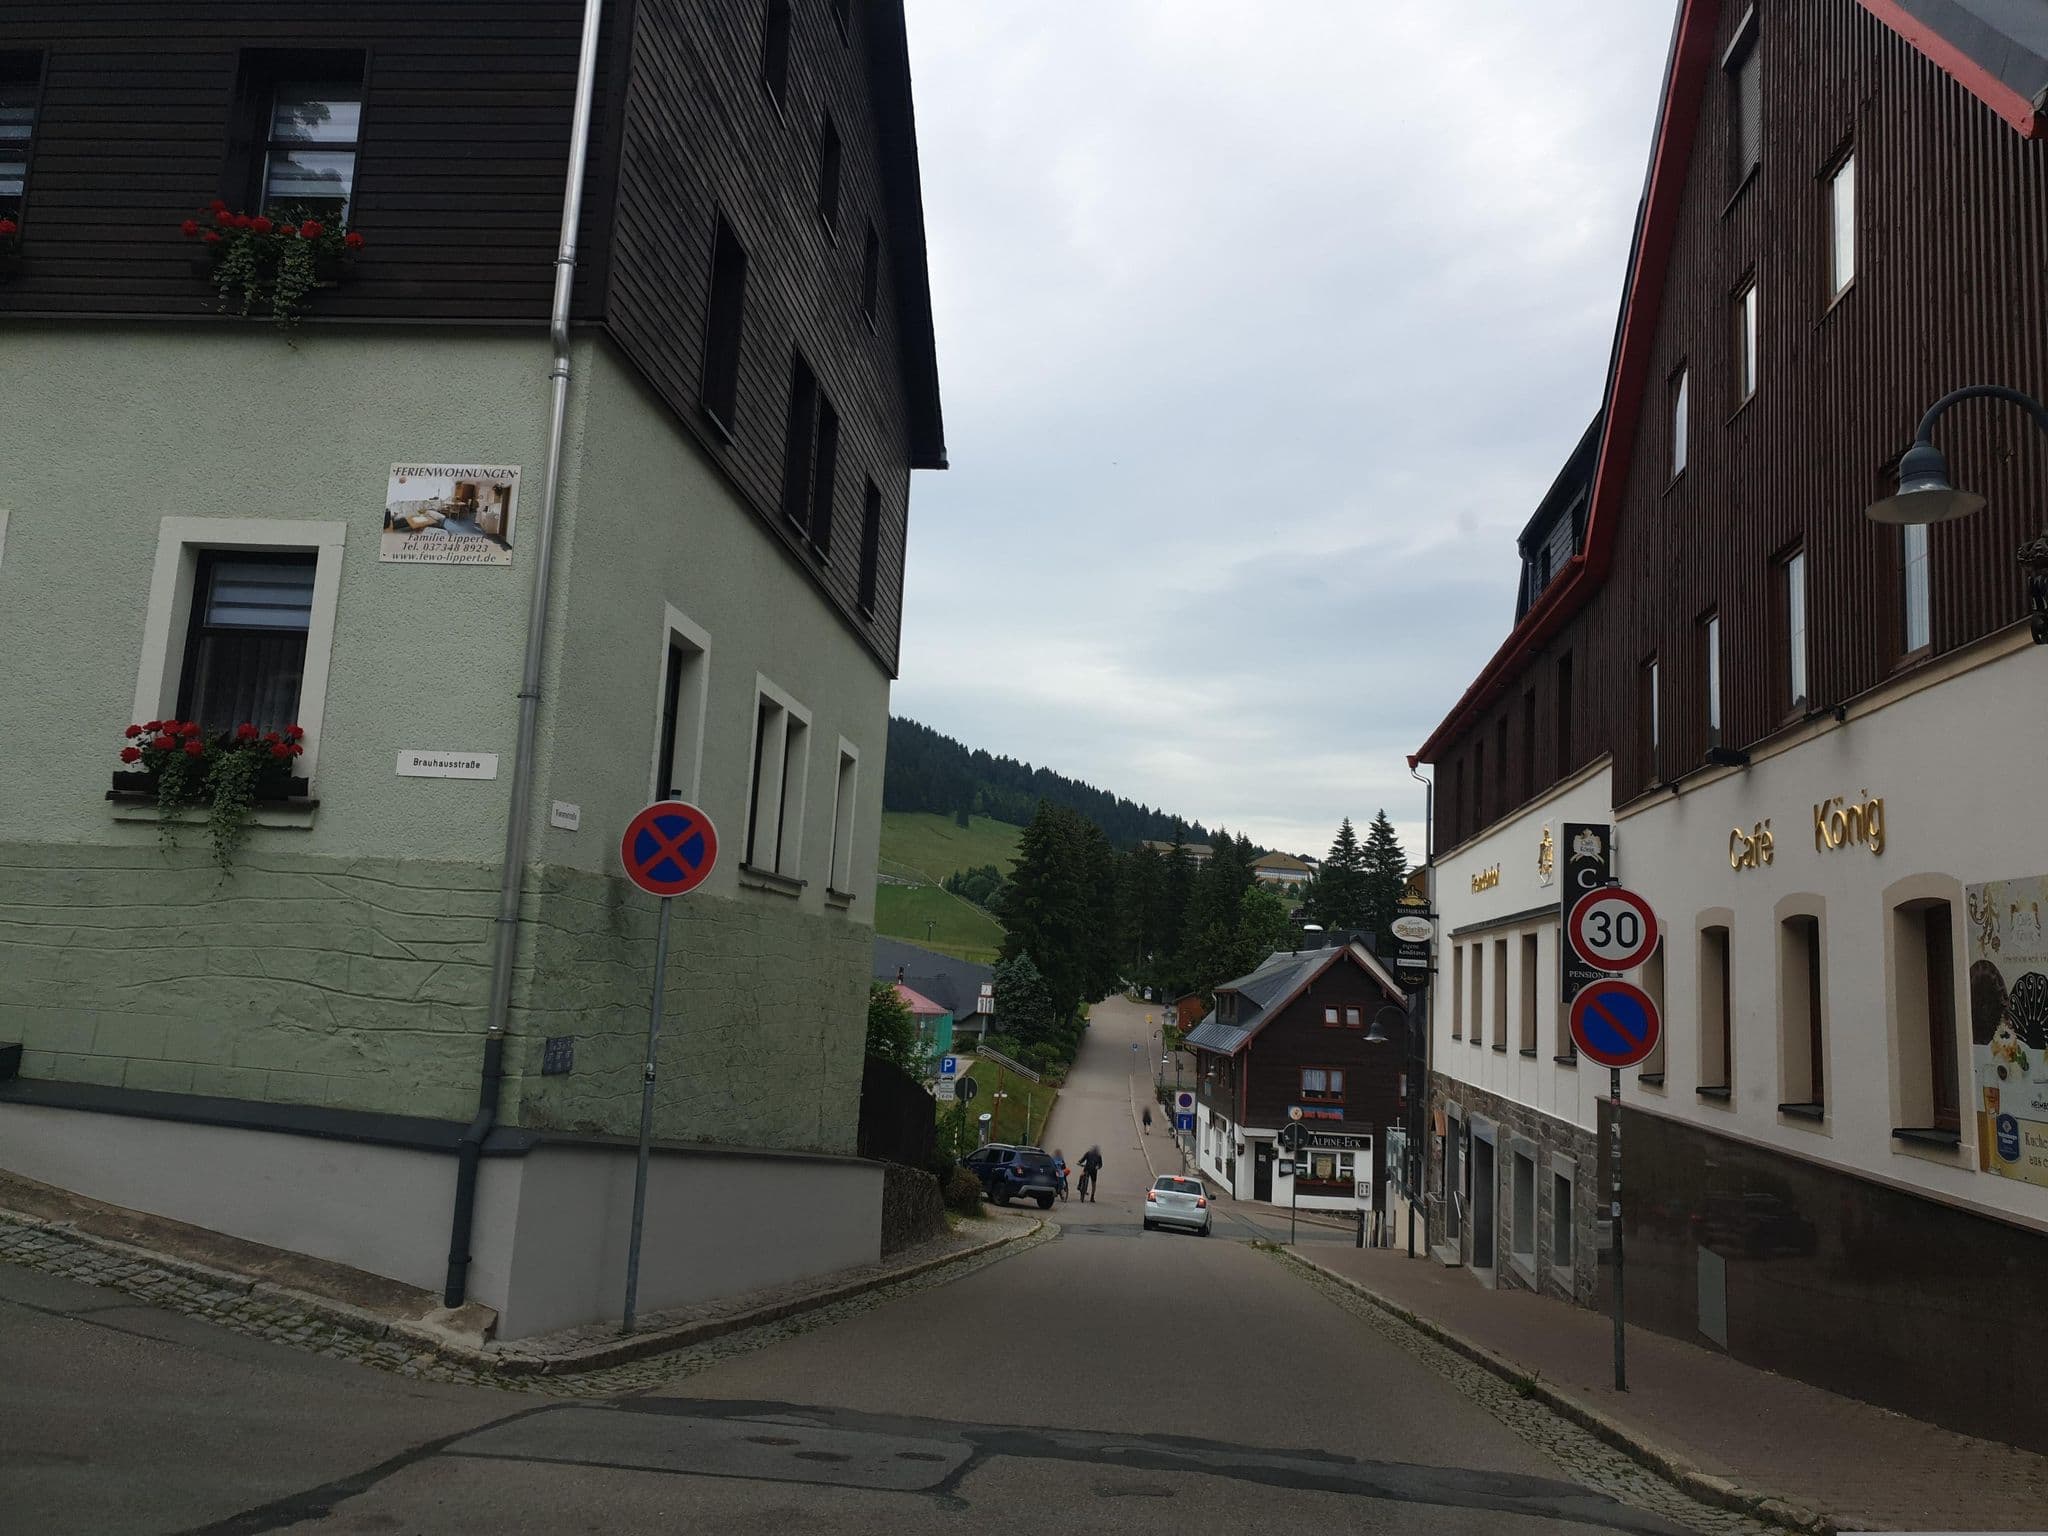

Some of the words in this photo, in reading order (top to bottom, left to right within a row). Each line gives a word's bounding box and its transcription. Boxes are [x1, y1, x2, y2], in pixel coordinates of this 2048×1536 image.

[395, 466, 516, 479] FERIENWOHNUNGEN
[408, 533, 446, 543] Familie
[448, 534, 486, 545] Lippert
[402, 542, 419, 551] Tel.
[422, 543, 460, 552] 037348
[463, 544, 489, 553] 8923
[392, 552, 497, 565] www.fewo-lippert.de
[413, 757, 481, 769] Brauhausstraße
[1729, 818, 1775, 872] Café
[1812, 788, 1887, 856] König
[1588, 911, 1639, 949] 30
[1568, 969, 1605, 979] PENSION
[943, 1058, 953, 1072] P
